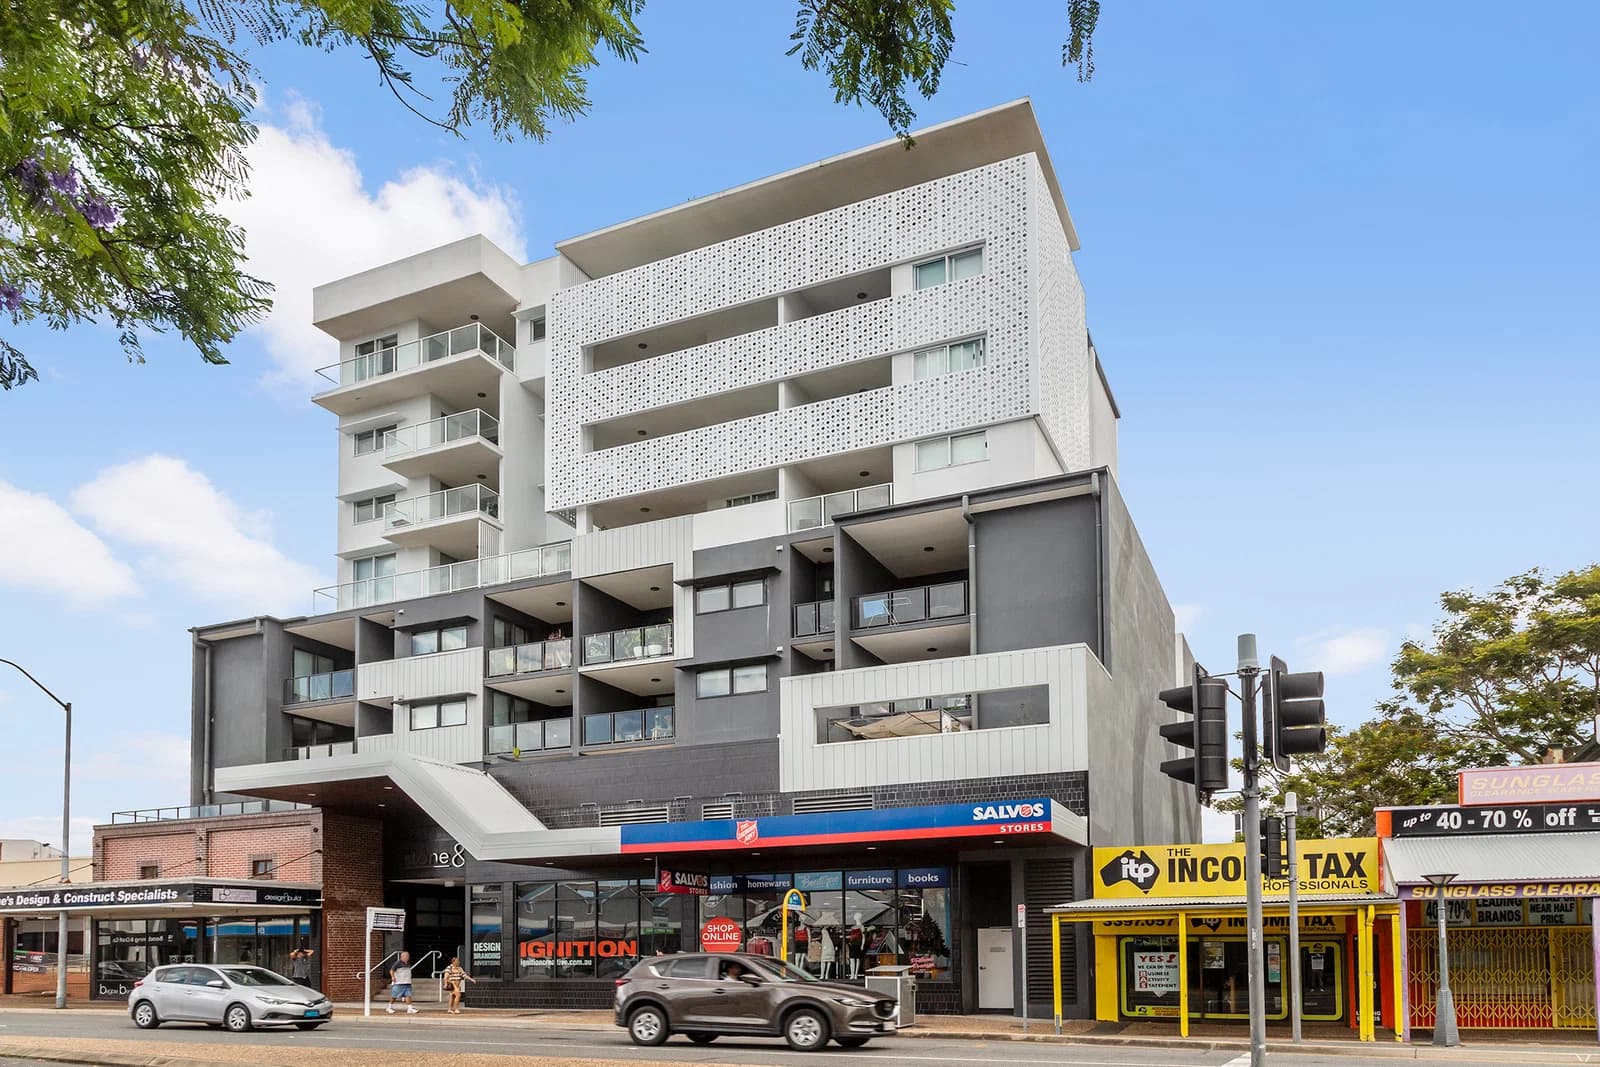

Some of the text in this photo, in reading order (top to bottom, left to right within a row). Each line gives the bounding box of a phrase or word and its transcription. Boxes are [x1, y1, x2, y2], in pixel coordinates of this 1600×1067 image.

[973, 803, 1044, 820] SALVOS
[1403, 815, 1417, 828] up
[1419, 812, 1432, 822] to
[1436, 811, 1462, 829] 40
[1480, 810, 1506, 828] 70
[1512, 809, 1532, 828] %
[1545, 807, 1576, 827] off
[1000, 823, 1043, 833] STORES
[1167, 848, 1191, 857] THE
[1121, 857, 1155, 883] itp
[1303, 852, 1367, 879] TAX
[675, 872, 708, 886] SALVOS
[747, 879, 790, 889] homewares
[848, 875, 892, 885] furniture
[908, 874, 939, 883] books
[16, 894, 50, 907] Design
[53, 893, 61, 904] &
[64, 891, 115, 904] Construct
[117, 889, 178, 903] Specialists
[1530, 902, 1574, 913] NEAR HALF
[1478, 910, 1521, 923] BRANDS
[1540, 914, 1565, 924] PRICE
[707, 925, 734, 933] SHOP
[702, 932, 739, 941] ONLINE
[473, 942, 501, 952] DESIGN
[520, 940, 638, 958] IGNITION
